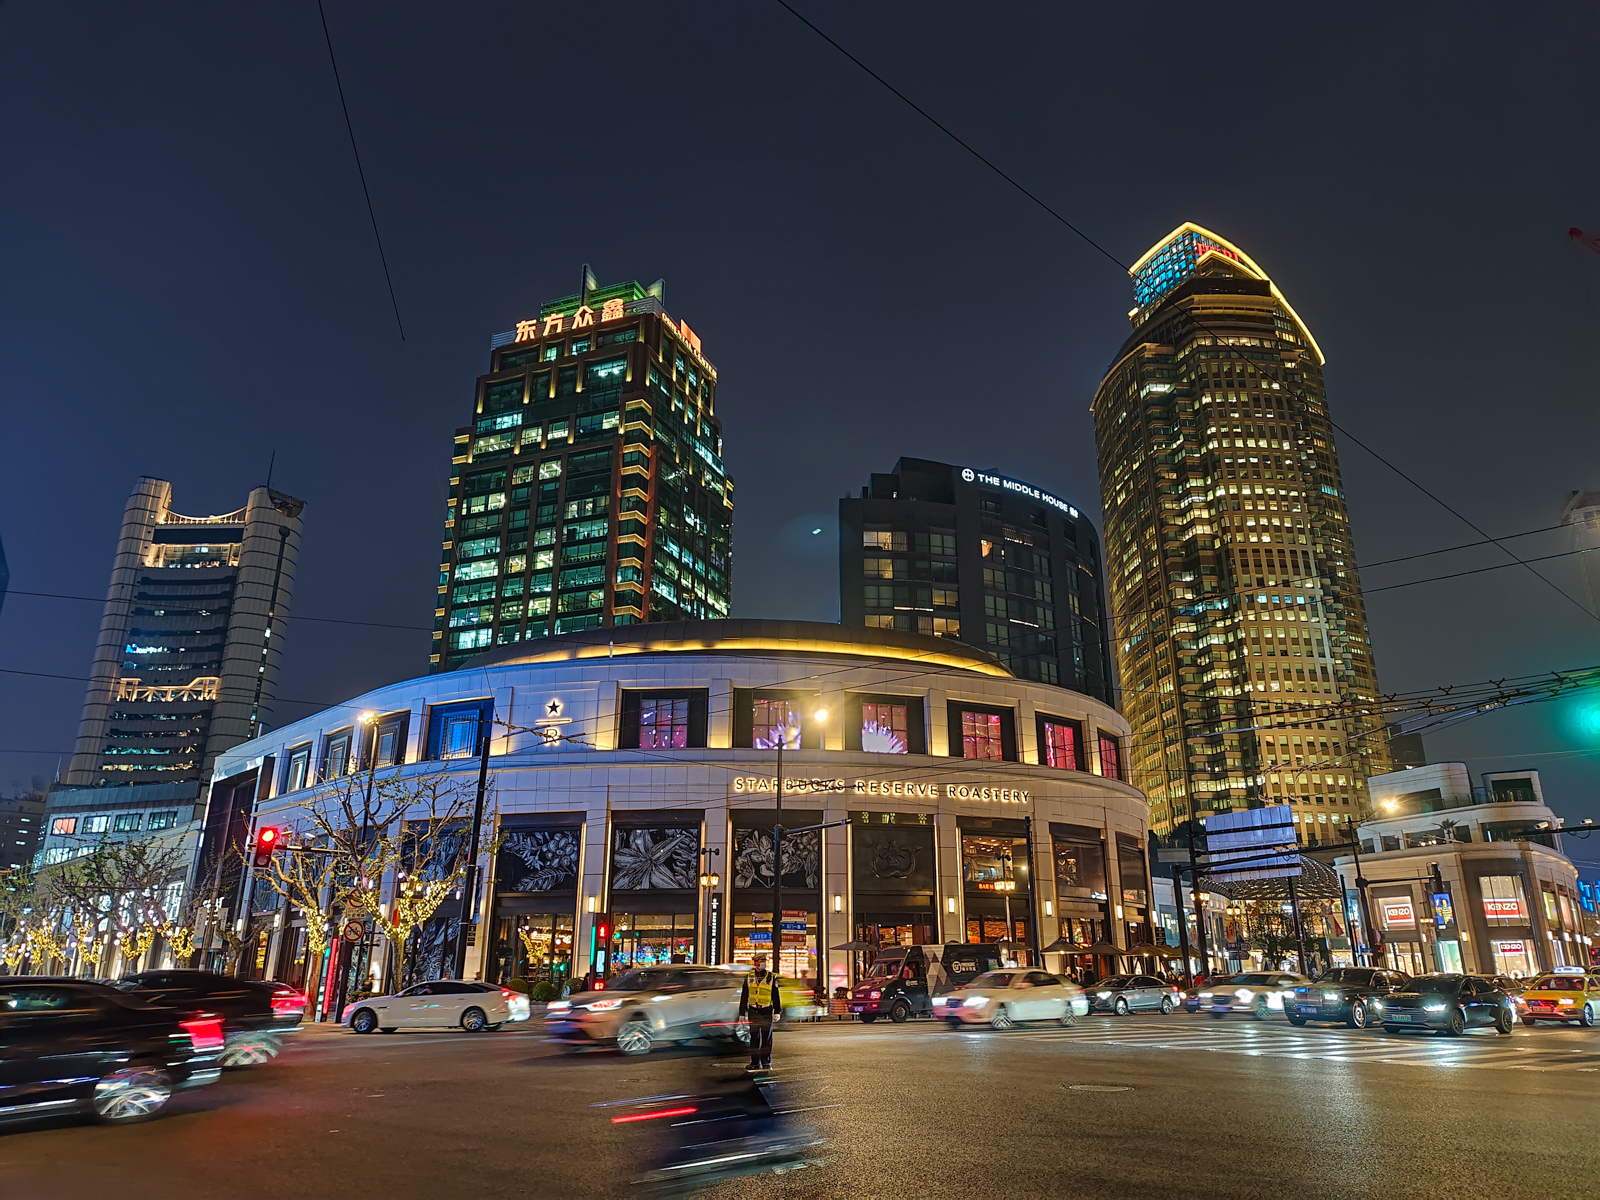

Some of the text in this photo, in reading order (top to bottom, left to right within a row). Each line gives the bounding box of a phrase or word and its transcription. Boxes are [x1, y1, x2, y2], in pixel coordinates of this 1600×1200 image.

[514, 298, 625, 343] 东方众鑫
[977, 473, 1000, 486] THE
[1003, 479, 1040, 499] MIDDLE
[1042, 493, 1069, 512] HOUSE
[734, 777, 1030, 803] STARBUCKS RESERVE ROASTERY
[1387, 907, 1410, 916] KENZO
[1487, 902, 1519, 911] KENZO
